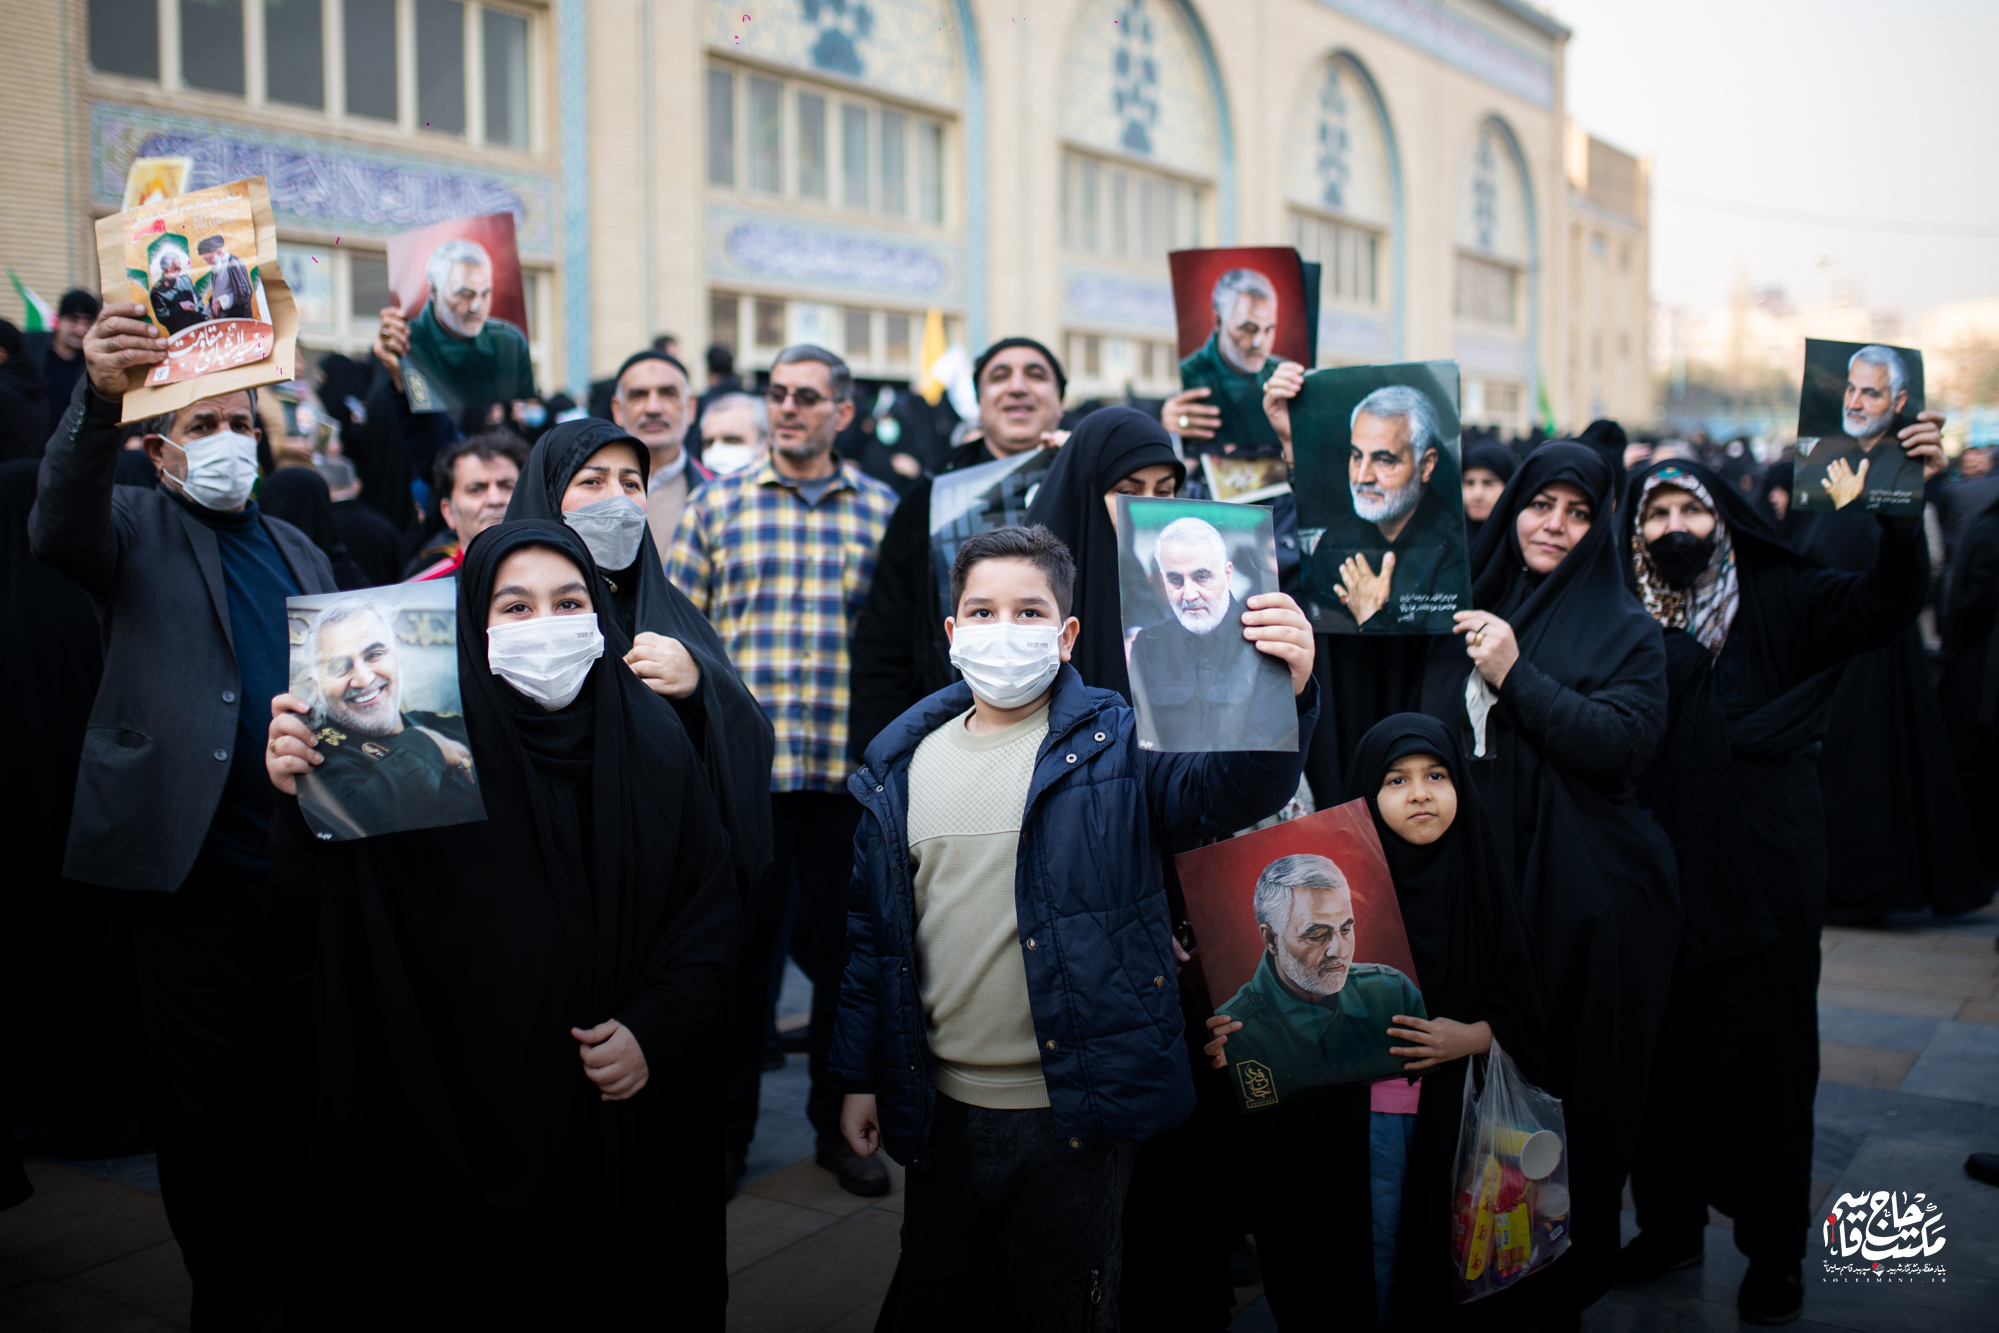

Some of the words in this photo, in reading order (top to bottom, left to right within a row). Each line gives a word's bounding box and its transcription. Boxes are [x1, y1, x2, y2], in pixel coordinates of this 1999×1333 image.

[179, 203, 194, 215] حاج
[193, 214, 208, 223] HAJ
[210, 208, 238, 219] QASEM
[194, 215, 238, 230] SOLEIMANI
